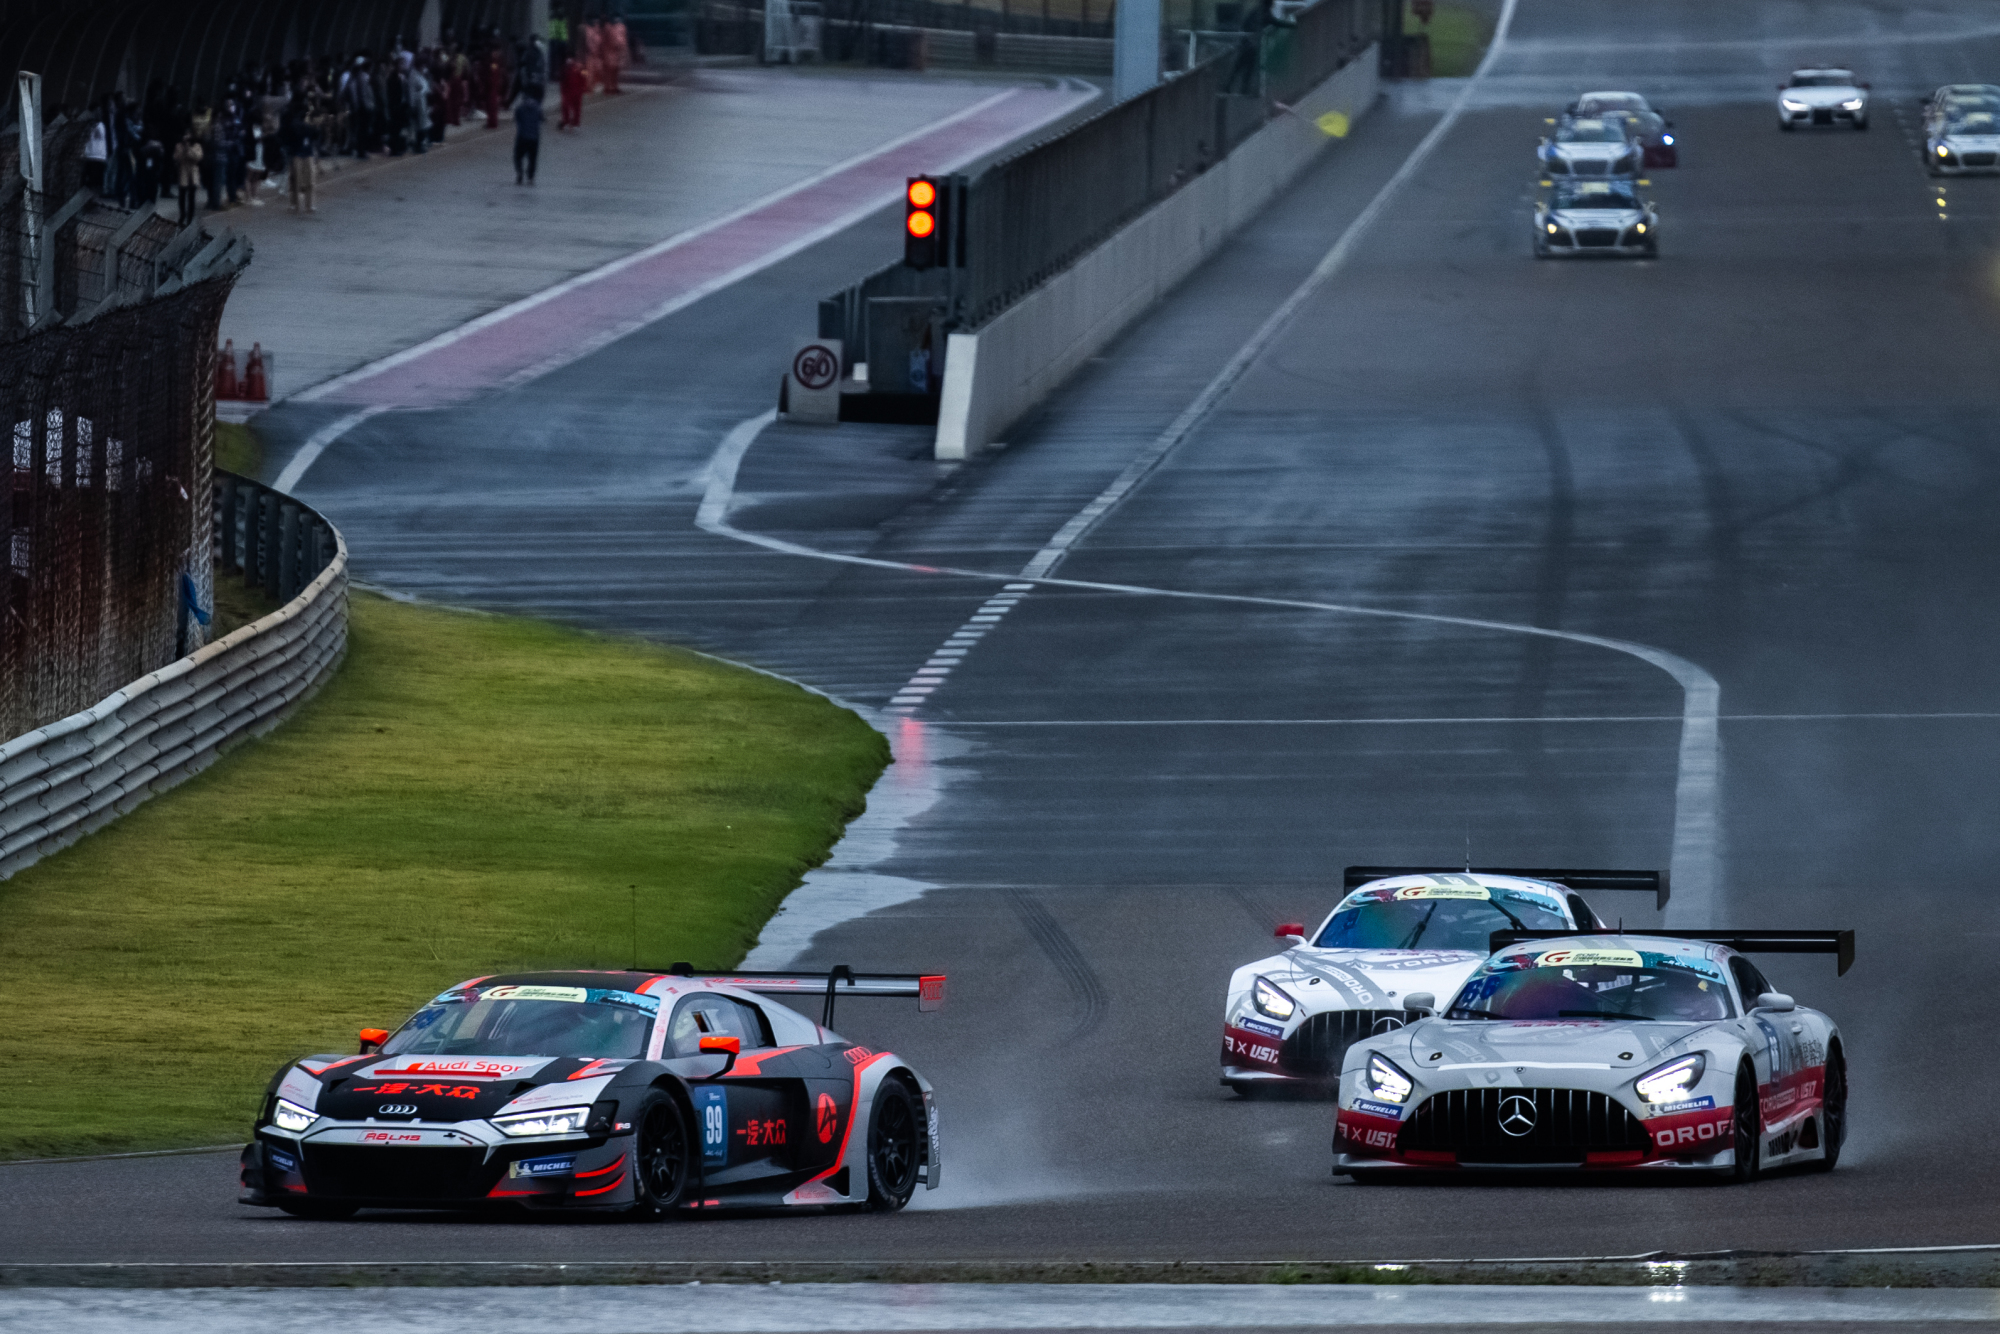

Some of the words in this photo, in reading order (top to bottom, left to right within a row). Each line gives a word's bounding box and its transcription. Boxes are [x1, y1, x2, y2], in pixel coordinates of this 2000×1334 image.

[802, 357, 830, 377] 60
[1246, 1021, 1280, 1036] MICHELIN
[423, 1061, 469, 1071] Audi
[474, 1061, 523, 1073] Spor
[1361, 1103, 1399, 1116] MICHELIN
[1664, 1099, 1709, 1112] MICHELIN
[705, 1105, 723, 1144] 99
[1649, 1122, 1715, 1147] ORO
[533, 1162, 575, 1172] MICHEL
